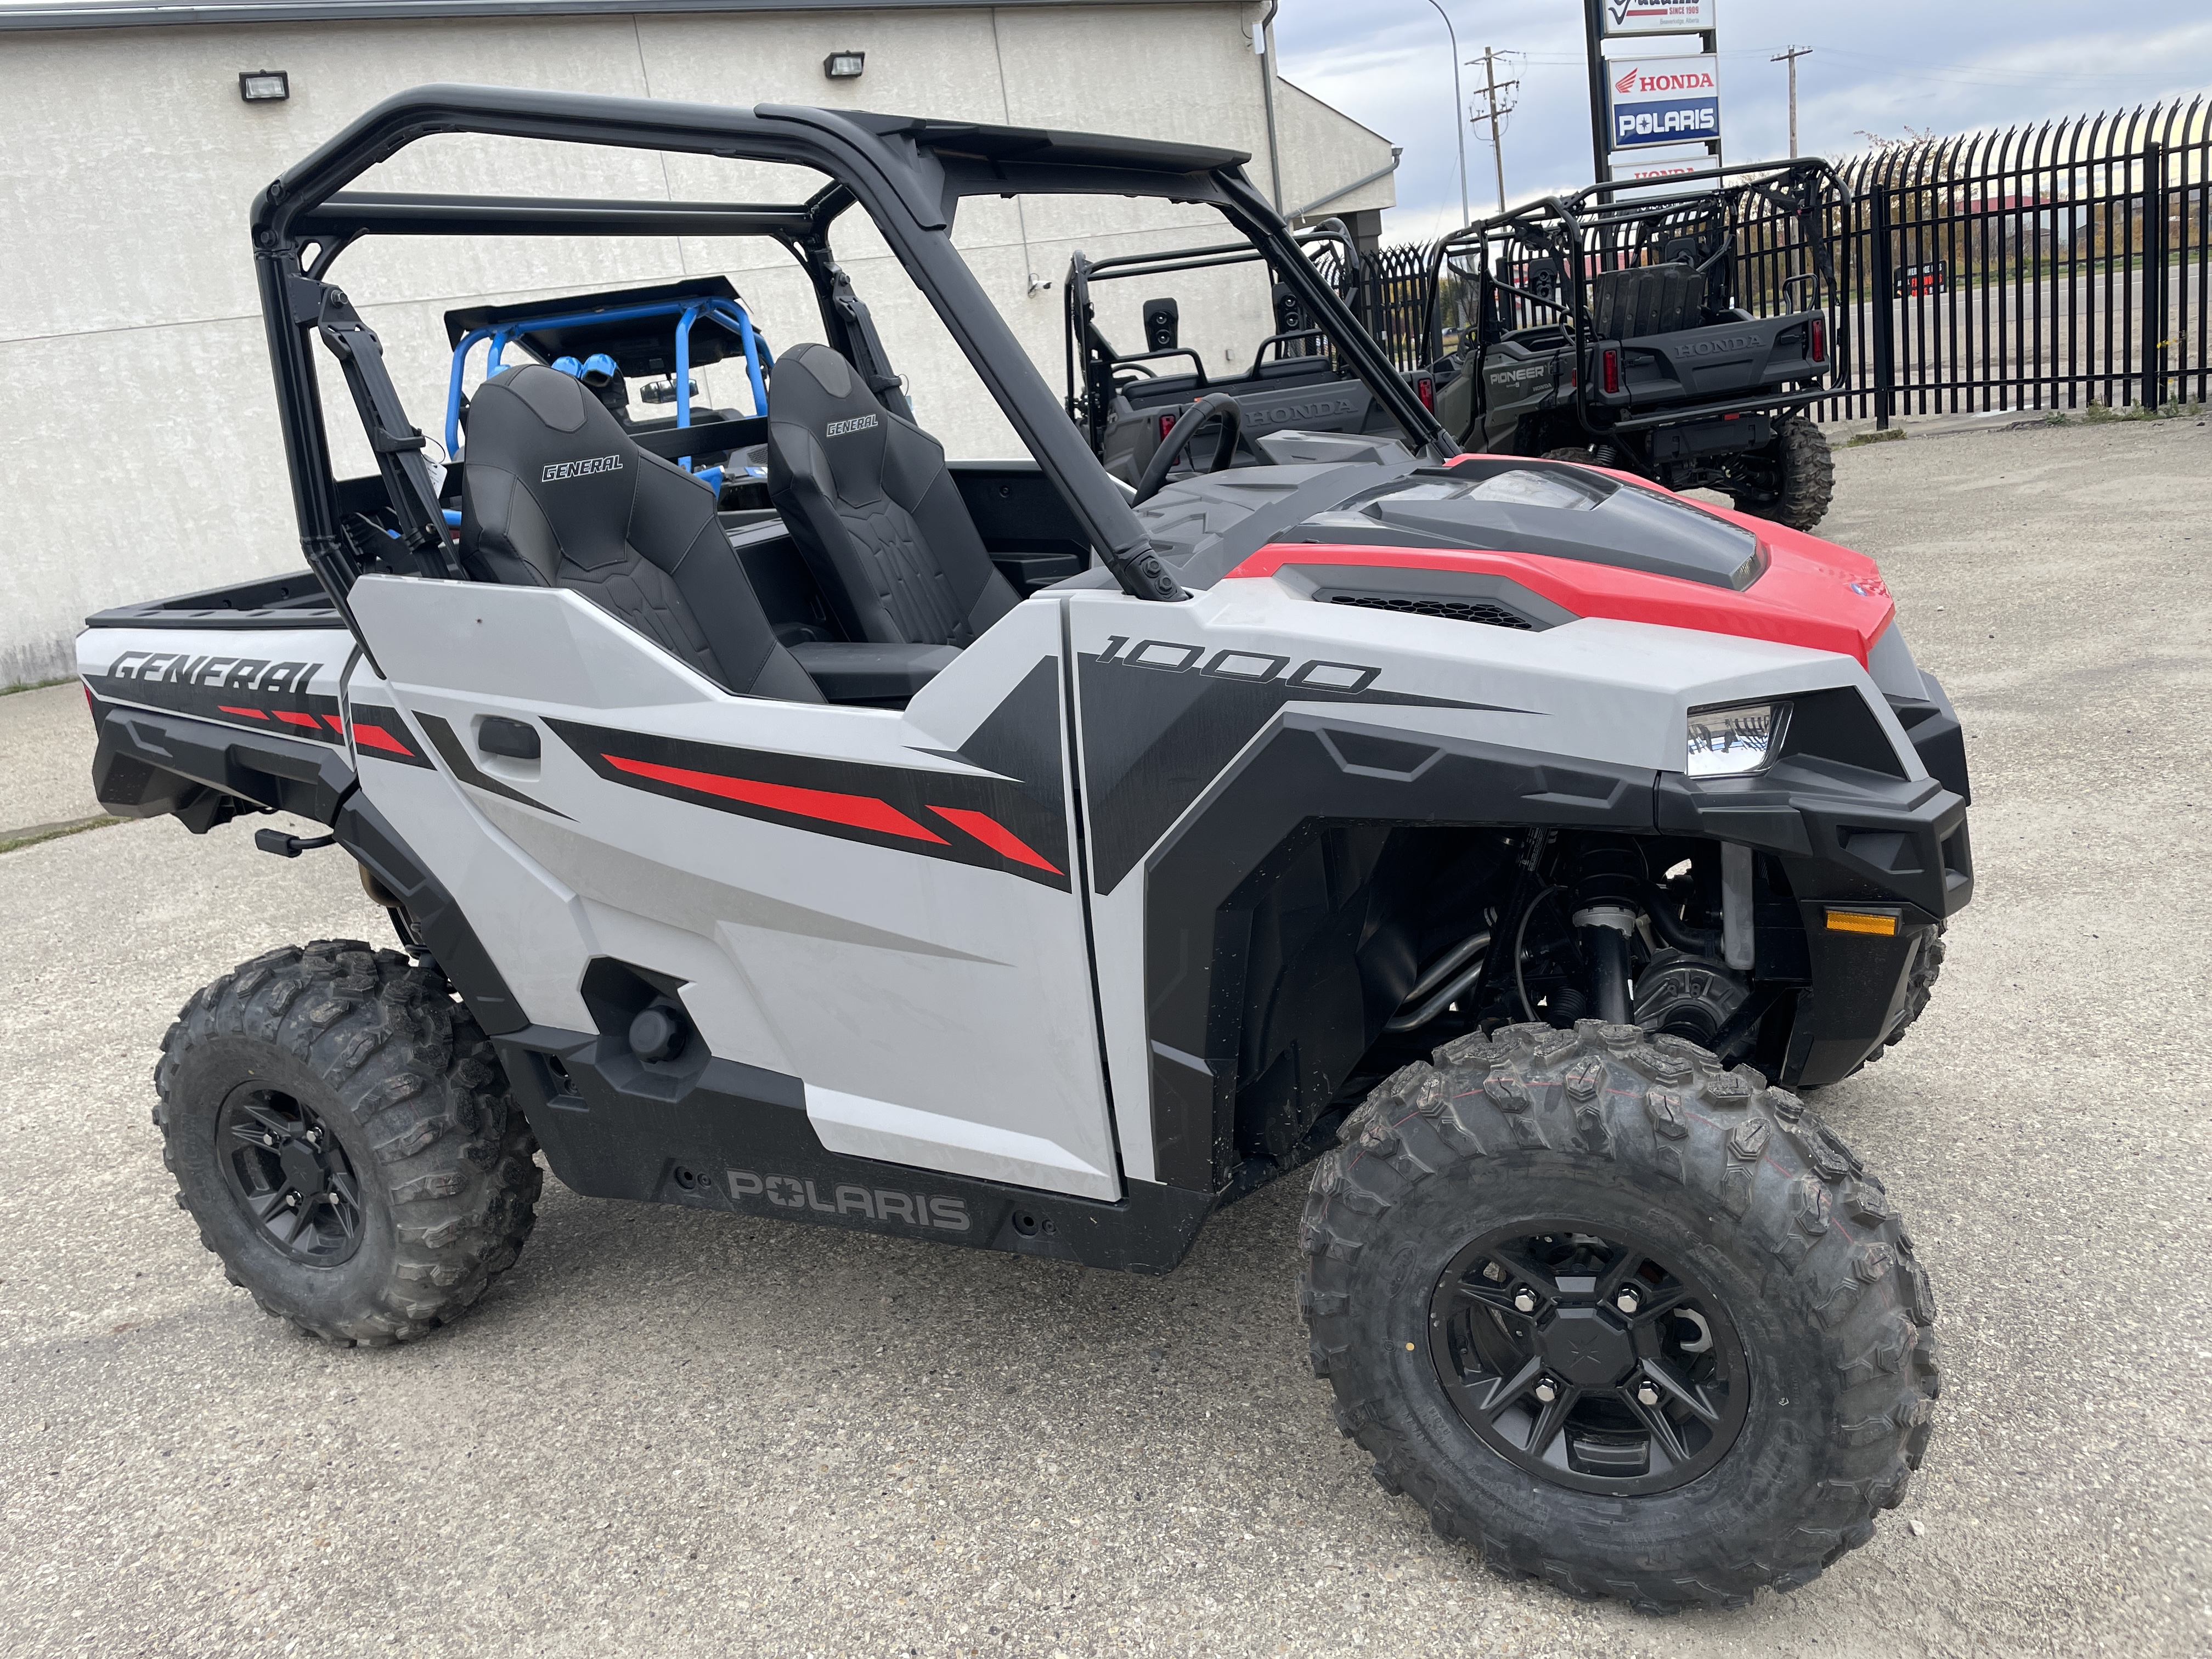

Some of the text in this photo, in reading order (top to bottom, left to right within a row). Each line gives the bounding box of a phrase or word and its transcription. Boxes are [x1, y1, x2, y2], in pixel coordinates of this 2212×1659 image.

[1669, 6, 1699, 15] SINCE 1909
[1639, 72, 1714, 92] HONDA
[1618, 108, 1715, 137] POLARIS
[1675, 335, 1767, 359] HONDA
[1490, 365, 1544, 385] PIONEER
[826, 414, 878, 437] GENERAL
[1245, 398, 1359, 427] HONDA
[541, 454, 623, 483] GENERAL
[108, 650, 325, 695] GENERAL
[1096, 635, 1382, 695] 1000
[725, 1169, 972, 1232] POLARIS
